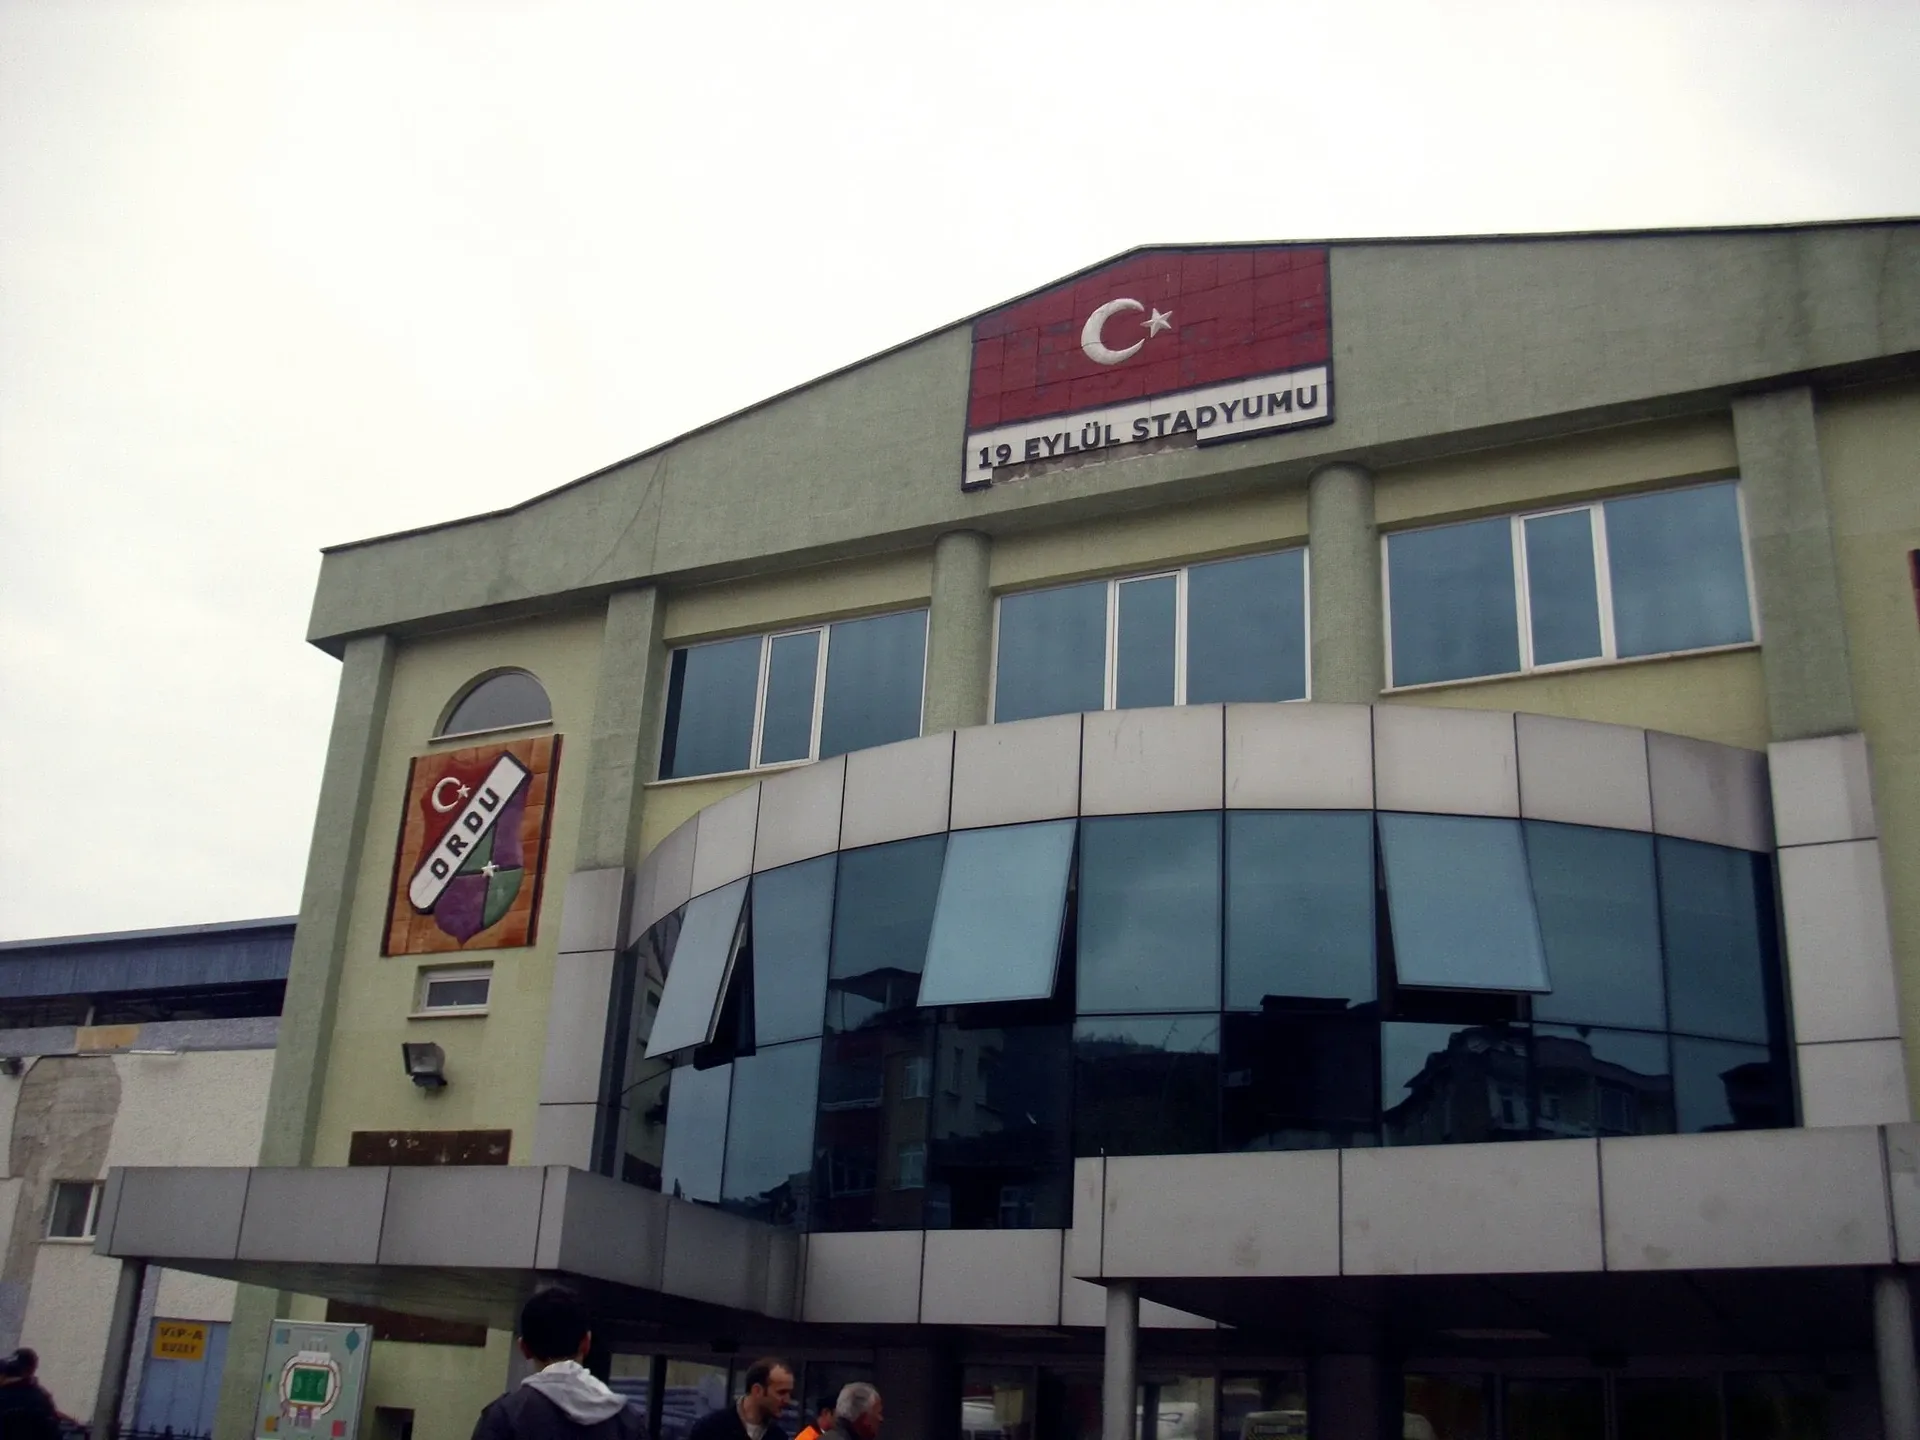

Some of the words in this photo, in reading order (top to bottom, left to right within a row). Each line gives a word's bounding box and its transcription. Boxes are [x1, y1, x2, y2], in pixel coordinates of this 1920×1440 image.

[979, 443, 1011, 469] 19
[1025, 422, 1120, 461] EYLÜL
[1132, 385, 1318, 441] STADYUMU
[431, 787, 499, 880] ORDU
